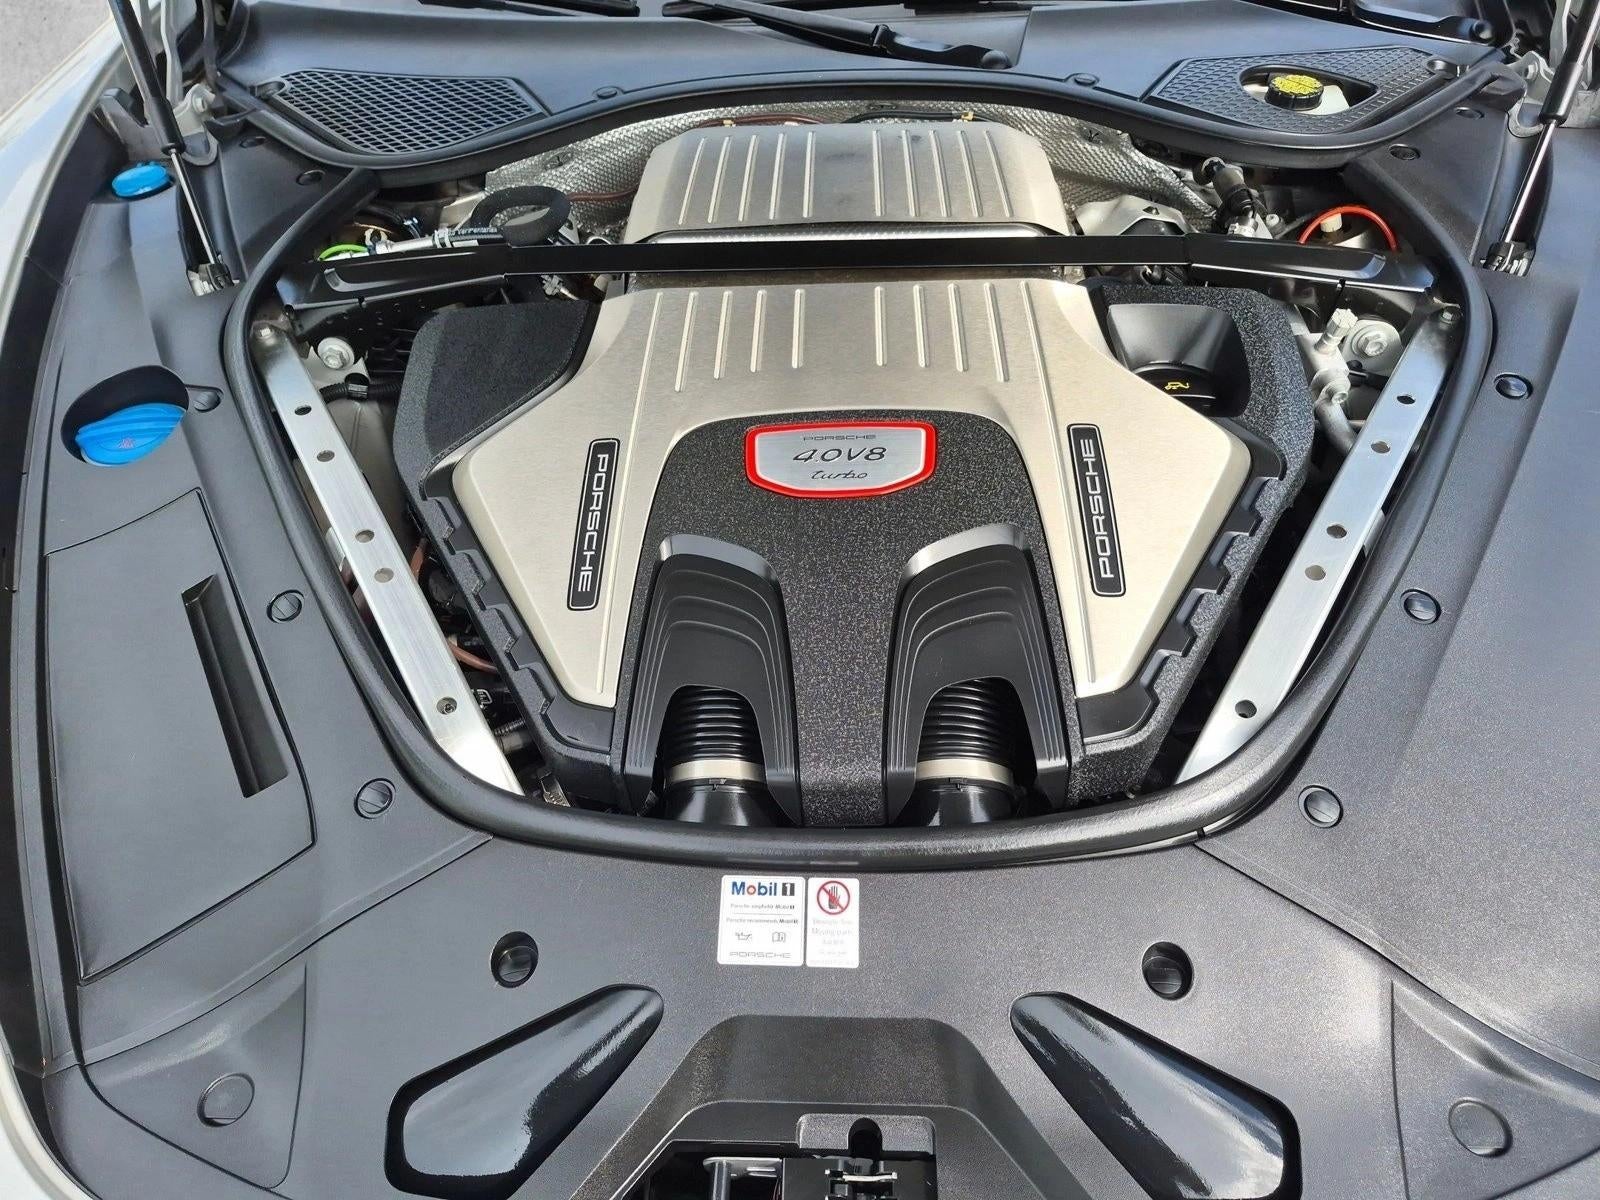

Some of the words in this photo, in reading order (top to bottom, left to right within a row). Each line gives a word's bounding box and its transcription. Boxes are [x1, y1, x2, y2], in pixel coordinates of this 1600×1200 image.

[811, 470, 868, 480] turbo
[1080, 439, 1115, 578] PORSCHE
[577, 453, 609, 592] PORSCHE
[731, 881, 777, 896] Mobil
[782, 883, 795, 896] 1
[729, 951, 792, 959] PORSCHE
